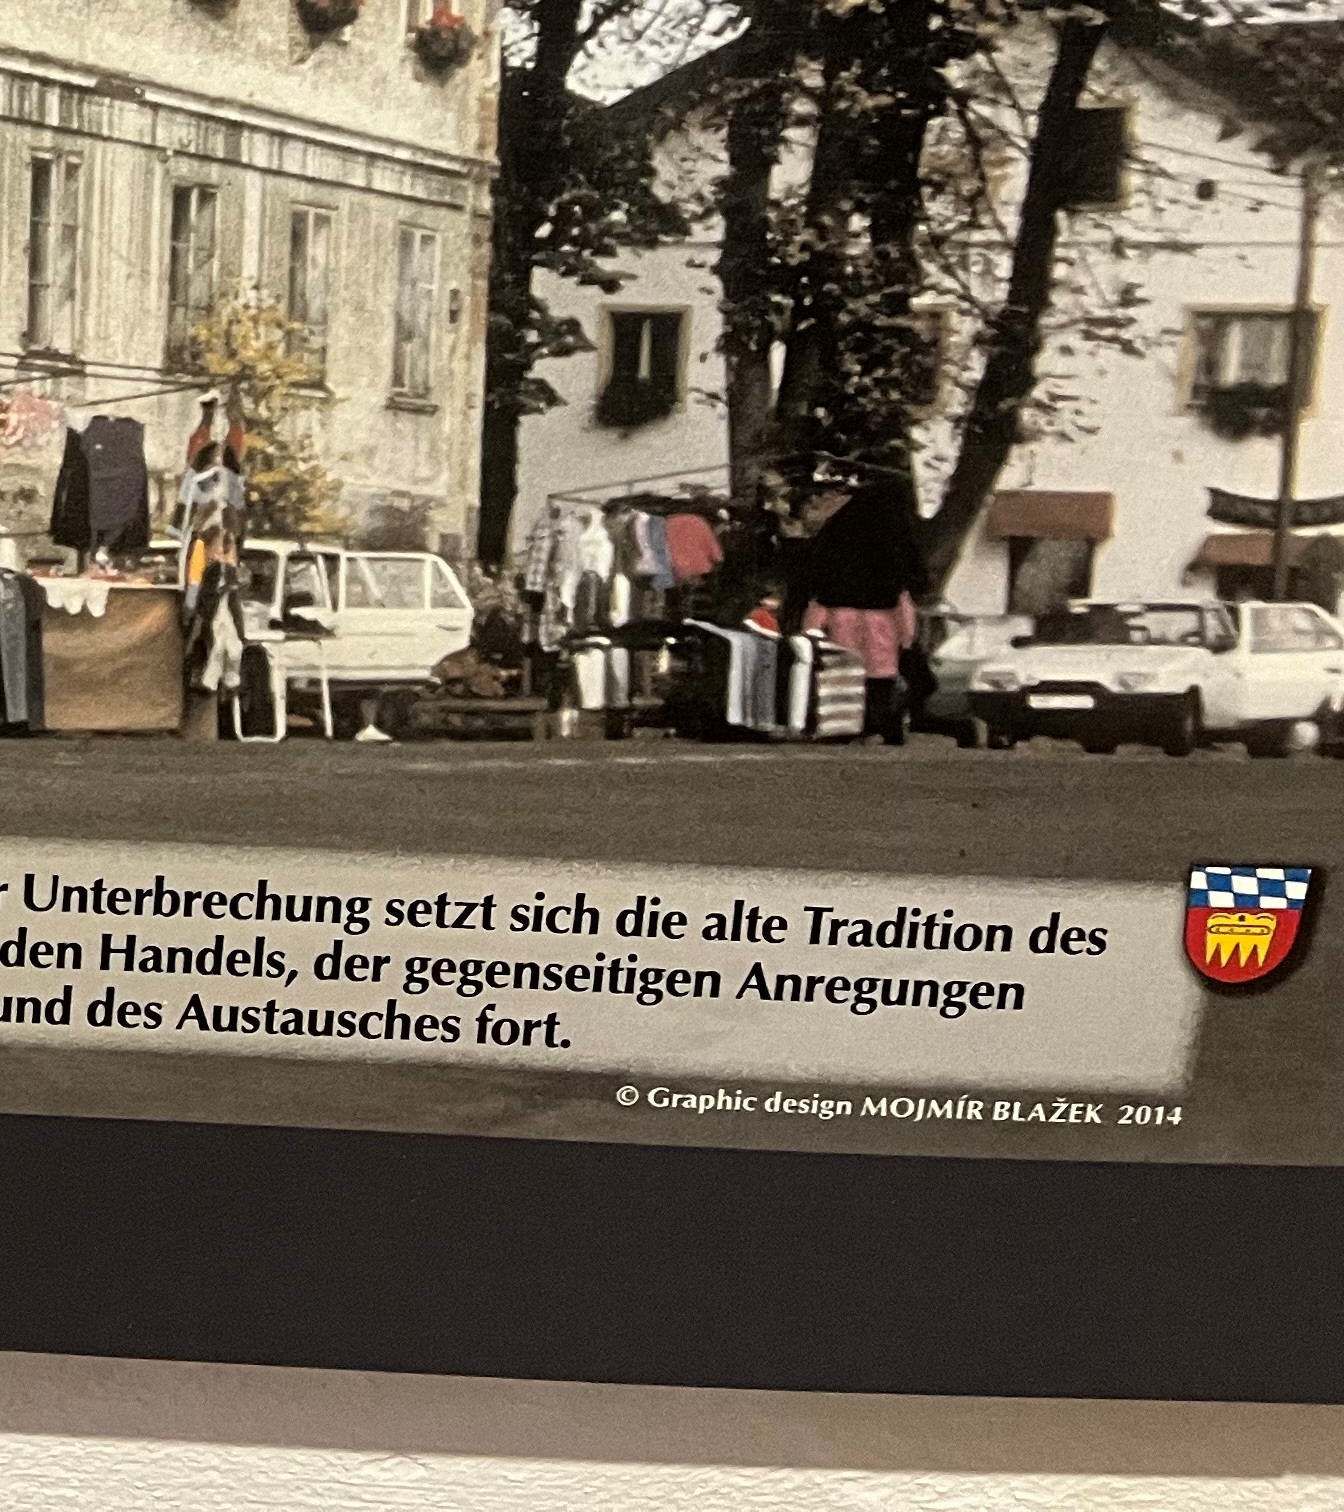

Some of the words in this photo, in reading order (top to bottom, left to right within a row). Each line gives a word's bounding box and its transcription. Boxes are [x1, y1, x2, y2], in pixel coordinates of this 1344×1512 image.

[23, 873, 372, 936] Unterbrechung
[384, 892, 497, 931] setzt
[509, 891, 600, 935] sich
[615, 895, 688, 940] die
[701, 899, 788, 944] alte
[803, 906, 1013, 952] Tradition
[1028, 912, 1108, 956] des
[99, 933, 298, 988] Handels,
[313, 939, 391, 983] der
[402, 952, 721, 1006] gegenseitigen
[735, 962, 1025, 1019] Anregungen
[86, 986, 163, 1030] des
[175, 993, 461, 1043] Austausches
[475, 1003, 571, 1049] fort.
[647, 1087, 758, 1114] Graphic
[764, 1091, 852, 1120] design
[860, 1097, 984, 1122] MOJMÍR
[992, 1097, 1103, 1124] BLAŽEK
[1117, 1105, 1182, 1125] 2014
